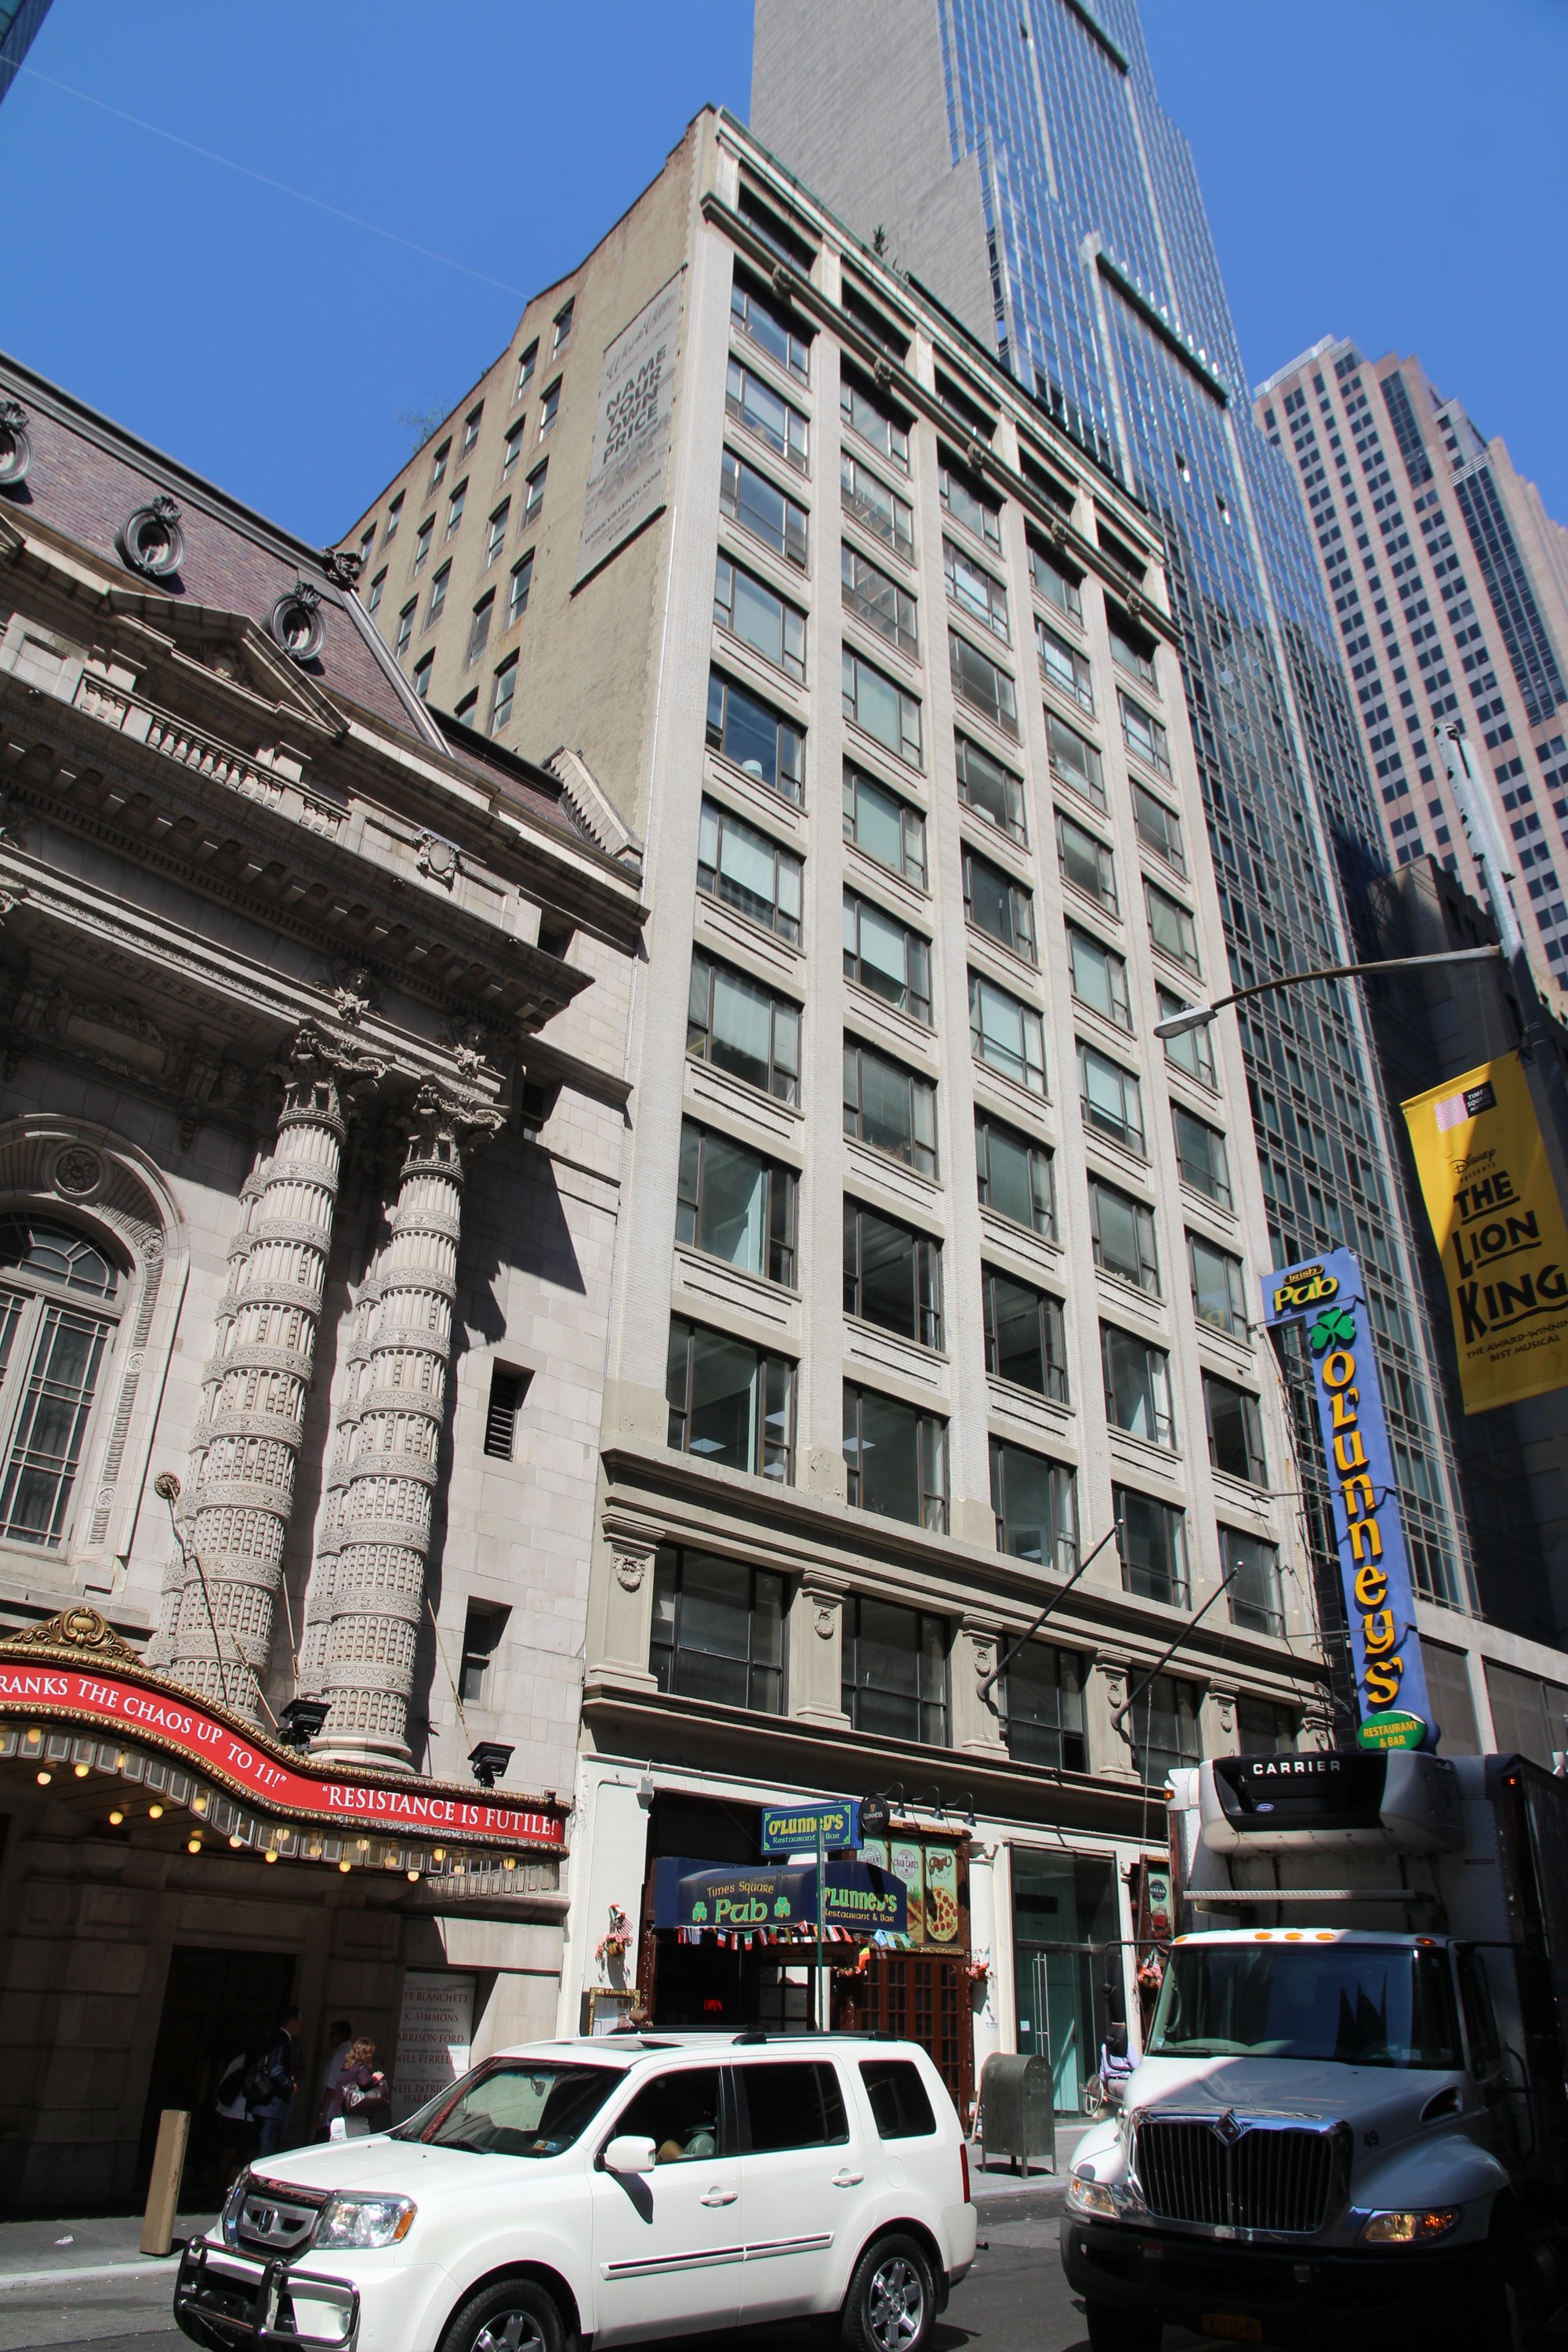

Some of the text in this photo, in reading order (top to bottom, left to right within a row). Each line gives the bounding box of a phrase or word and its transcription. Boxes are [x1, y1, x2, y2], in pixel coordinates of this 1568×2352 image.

[607, 344, 666, 416] NAME
[608, 365, 662, 427] YOUR
[607, 383, 659, 445] OWN
[603, 400, 659, 465] PRICE
[1453, 1171, 1514, 1219] THE
[1452, 1210, 1540, 1280] LION
[1273, 1275, 1339, 1312] Pub
[1457, 1265, 1568, 1345] KING
[1466, 1346, 1485, 1359] THE
[1490, 1334, 1562, 1363] BEST MUSICAL
[78, 1679, 119, 1708] THE
[123, 1697, 193, 1734] CHAOS
[197, 1722, 223, 1744] UP
[227, 1742, 252, 1769] TO
[1363, 1720, 1418, 1738] RESTAURANT
[1380, 1735, 1406, 1748] & BAR
[1253, 1760, 1340, 1775] CARRIER
[461, 1804, 478, 1825] IS
[863, 1811, 883, 1820] GUINNESS
[772, 1835, 816, 1844] Restaurant
[906, 1860, 919, 1869] CAKES
[707, 1881, 775, 1897] Times Square
[715, 1897, 768, 1923] Pub
[873, 1913, 877, 1922] &
[880, 1913, 895, 1922] Bar
[417, 1992, 469, 2003] BLANCHETT
[703, 1998, 722, 2011] OPEN
[416, 2013, 458, 2023] SIMMONS
[439, 2034, 464, 2044] FORD
[419, 2054, 455, 2064] FERRELL
[1363, 2130, 1380, 2147] 49
